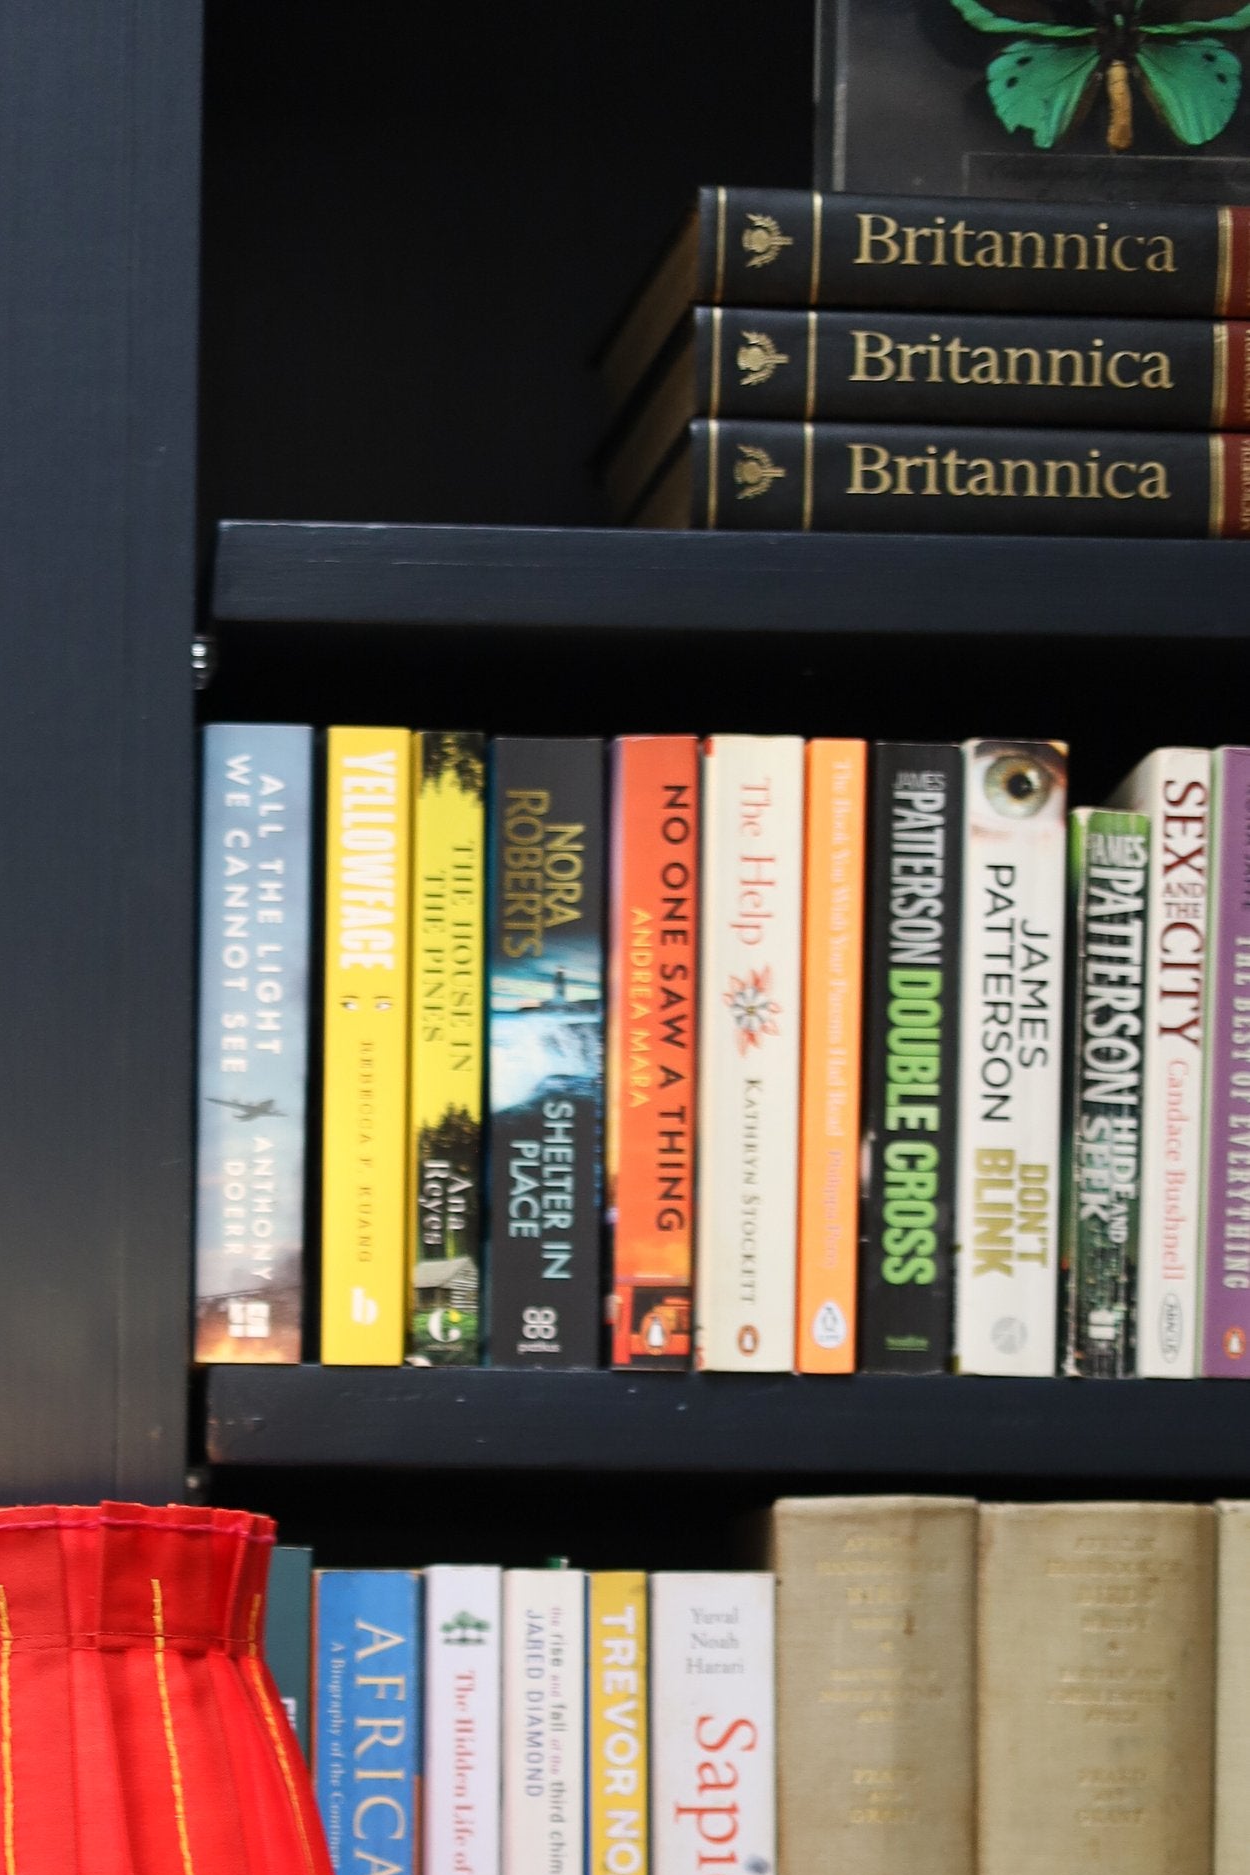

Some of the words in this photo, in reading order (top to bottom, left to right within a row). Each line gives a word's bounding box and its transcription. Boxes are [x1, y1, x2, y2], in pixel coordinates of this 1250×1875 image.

[853, 213, 1178, 272] Britannica
[848, 330, 1175, 390] Britannica
[846, 443, 1172, 500] Britannica
[224, 753, 252, 809] WE
[259, 773, 286, 841] ALL
[662, 784, 688, 846] NO
[738, 777, 774, 838] The
[340, 751, 398, 971] YELLOWFACE
[450, 840, 476, 908] THE
[502, 788, 550, 959] ROBERTS
[1161, 780, 1207, 877] SEX
[221, 828, 251, 993] CANNOT
[258, 858, 285, 928] THE
[422, 872, 448, 935] THE
[546, 822, 586, 930] NORA
[660, 862, 689, 947] ONE
[729, 854, 776, 946] Help
[889, 792, 946, 965] PATTERSON
[255, 943, 284, 1057] LIGHT
[422, 947, 446, 1044] PINES
[450, 920, 475, 1029] HOUSE
[630, 907, 653, 1020] ANDREA
[658, 964, 689, 1051] SAW
[978, 862, 1018, 1123] PATTERSON
[1017, 918, 1053, 1070] JAMES
[1082, 867, 1146, 1106] PATTERSON
[1158, 921, 1204, 1047] CITY
[220, 1011, 249, 1075] SEE
[450, 1040, 472, 1074] IN
[628, 1030, 652, 1109] MARA
[658, 1066, 686, 1092] A
[884, 968, 944, 1132] DOUBLE
[742, 1079, 763, 1186] KATHRYN
[1162, 1058, 1190, 1162] Candace
[422, 1159, 450, 1247] Reyes
[446, 1173, 475, 1232] Ana
[508, 1141, 541, 1239] PLACE
[542, 1101, 575, 1230] SHELTER
[656, 1106, 687, 1234] THING
[1078, 1112, 1111, 1221] SEEK
[1110, 1115, 1141, 1200] HIDE
[221, 1161, 246, 1258] DOERR
[252, 1136, 275, 1282] ANTHONY
[740, 1193, 762, 1306] STOCKETT
[880, 1140, 940, 1286] CROSS
[971, 1146, 1017, 1280] BLINK
[1017, 1163, 1052, 1269] DON'T
[1108, 1202, 1130, 1244] AND
[1161, 1170, 1187, 1281] Bushnell
[541, 1244, 572, 1280] IN
[455, 1670, 476, 1714] The
[526, 1609, 544, 1681] JARED
[552, 1633, 565, 1669] rise
[524, 1689, 544, 1798] DIAMOND
[551, 1703, 566, 1733] fall
[601, 1604, 636, 1796] TREVOR
[453, 1718, 475, 1800] Hidden
[550, 1782, 566, 1824] third
[454, 1853, 475, 1875] of
[455, 1803, 476, 1848] Life
